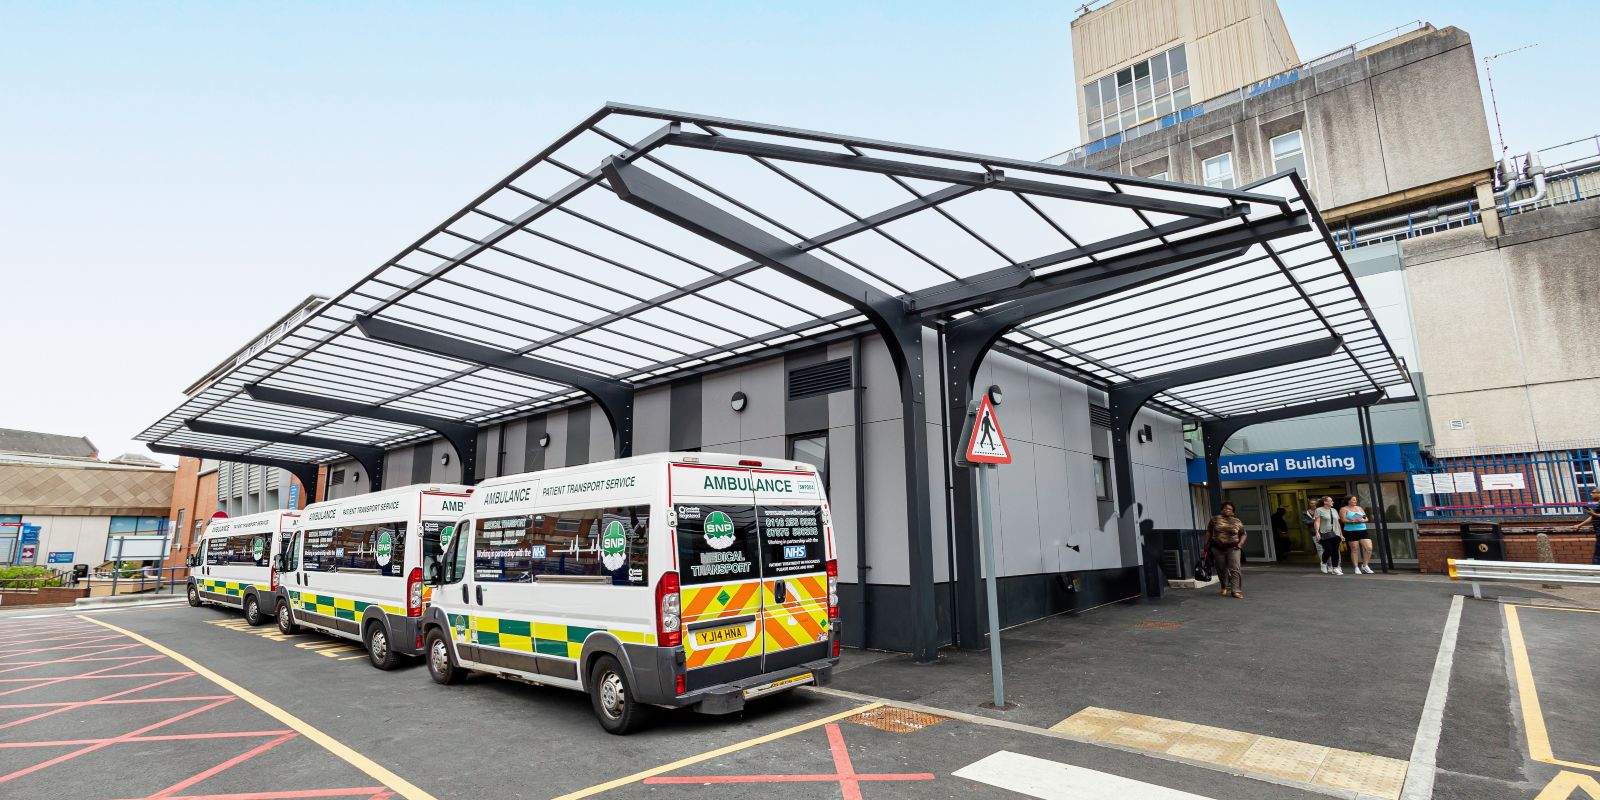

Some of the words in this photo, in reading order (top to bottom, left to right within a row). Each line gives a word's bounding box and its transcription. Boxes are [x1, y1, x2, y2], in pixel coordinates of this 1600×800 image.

[1221, 459, 1279, 474] almoral
[1285, 455, 1355, 471] Building
[542, 485, 566, 497] PATIENT
[567, 480, 605, 493] TRANSPORT
[605, 476, 636, 490] SERVICE
[703, 475, 793, 493] AMBULANCE
[483, 487, 532, 506] AMBULANCE
[309, 508, 337, 521] AMBULANCE
[706, 524, 732, 533] SNP
[604, 538, 624, 549] SNP
[476, 549, 491, 559] Working
[495, 548, 515, 559] partnership
[515, 547, 524, 557] with
[532, 546, 545, 557] NHS
[700, 551, 745, 564] MEDICAL
[785, 546, 805, 558] NHS
[691, 562, 752, 577] TRANSPORT
[702, 631, 723, 643] YJ14
[724, 627, 742, 639] HNA
